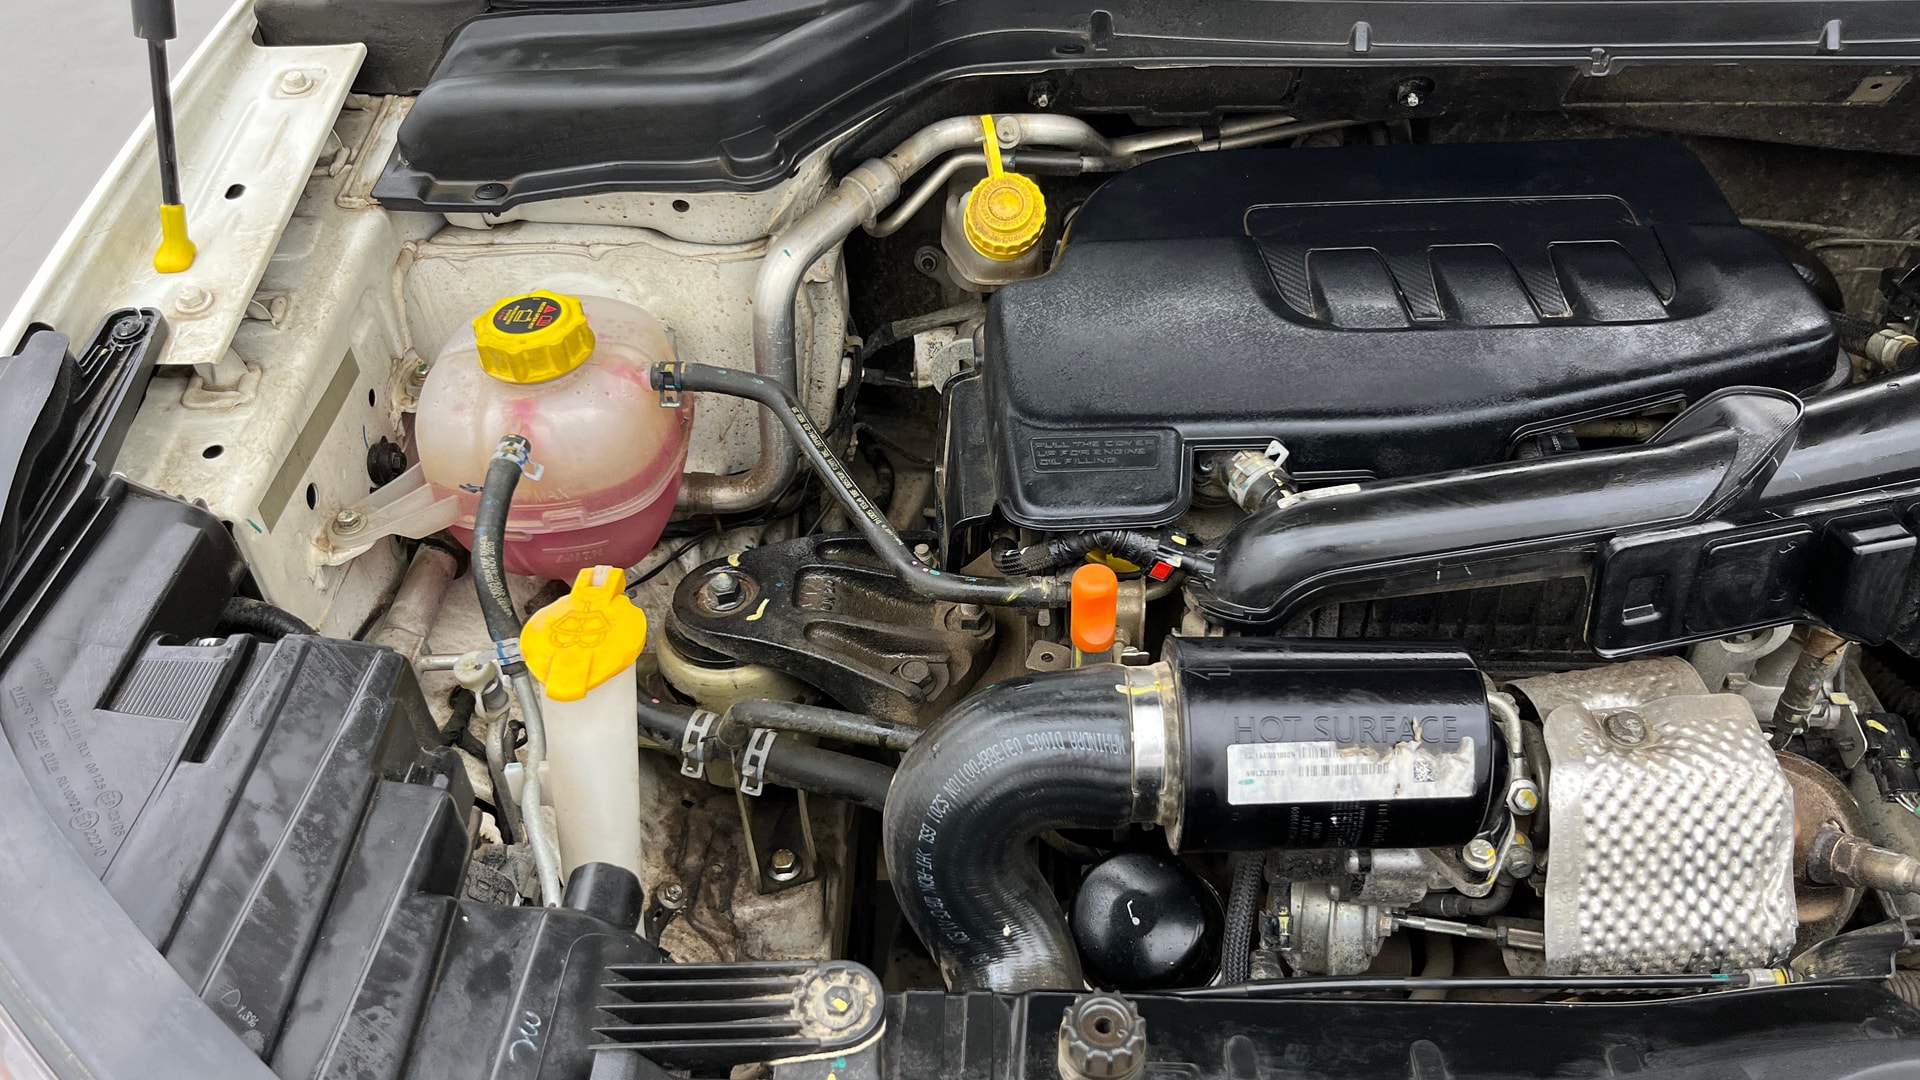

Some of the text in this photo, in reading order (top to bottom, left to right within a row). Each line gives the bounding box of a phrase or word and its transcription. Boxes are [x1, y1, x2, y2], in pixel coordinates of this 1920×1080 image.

[1234, 716, 1459, 743] HOT SURFACE
[1068, 731, 1126, 756] MAHINDRA
[926, 794, 950, 824] S201
[918, 822, 937, 844] GSL
